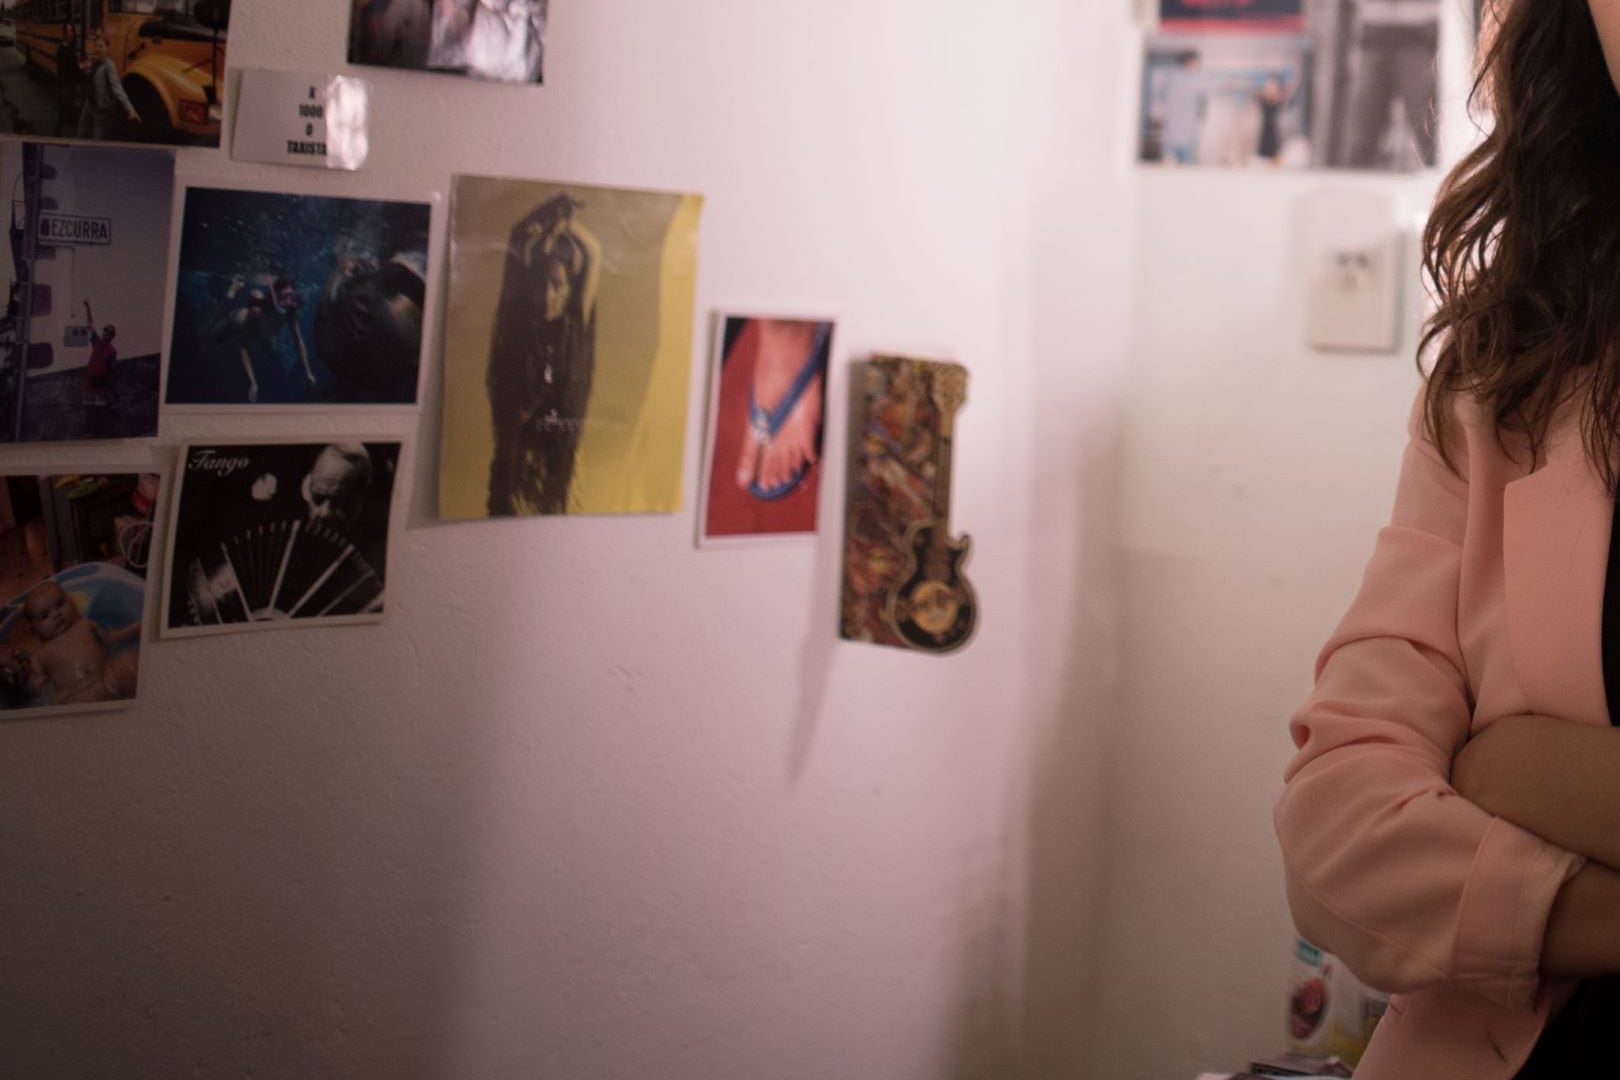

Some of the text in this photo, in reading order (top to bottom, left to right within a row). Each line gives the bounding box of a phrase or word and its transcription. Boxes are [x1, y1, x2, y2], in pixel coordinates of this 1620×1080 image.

[299, 104, 323, 118] 1000
[51, 219, 108, 239] EZCURRA
[188, 449, 250, 477] Tango
